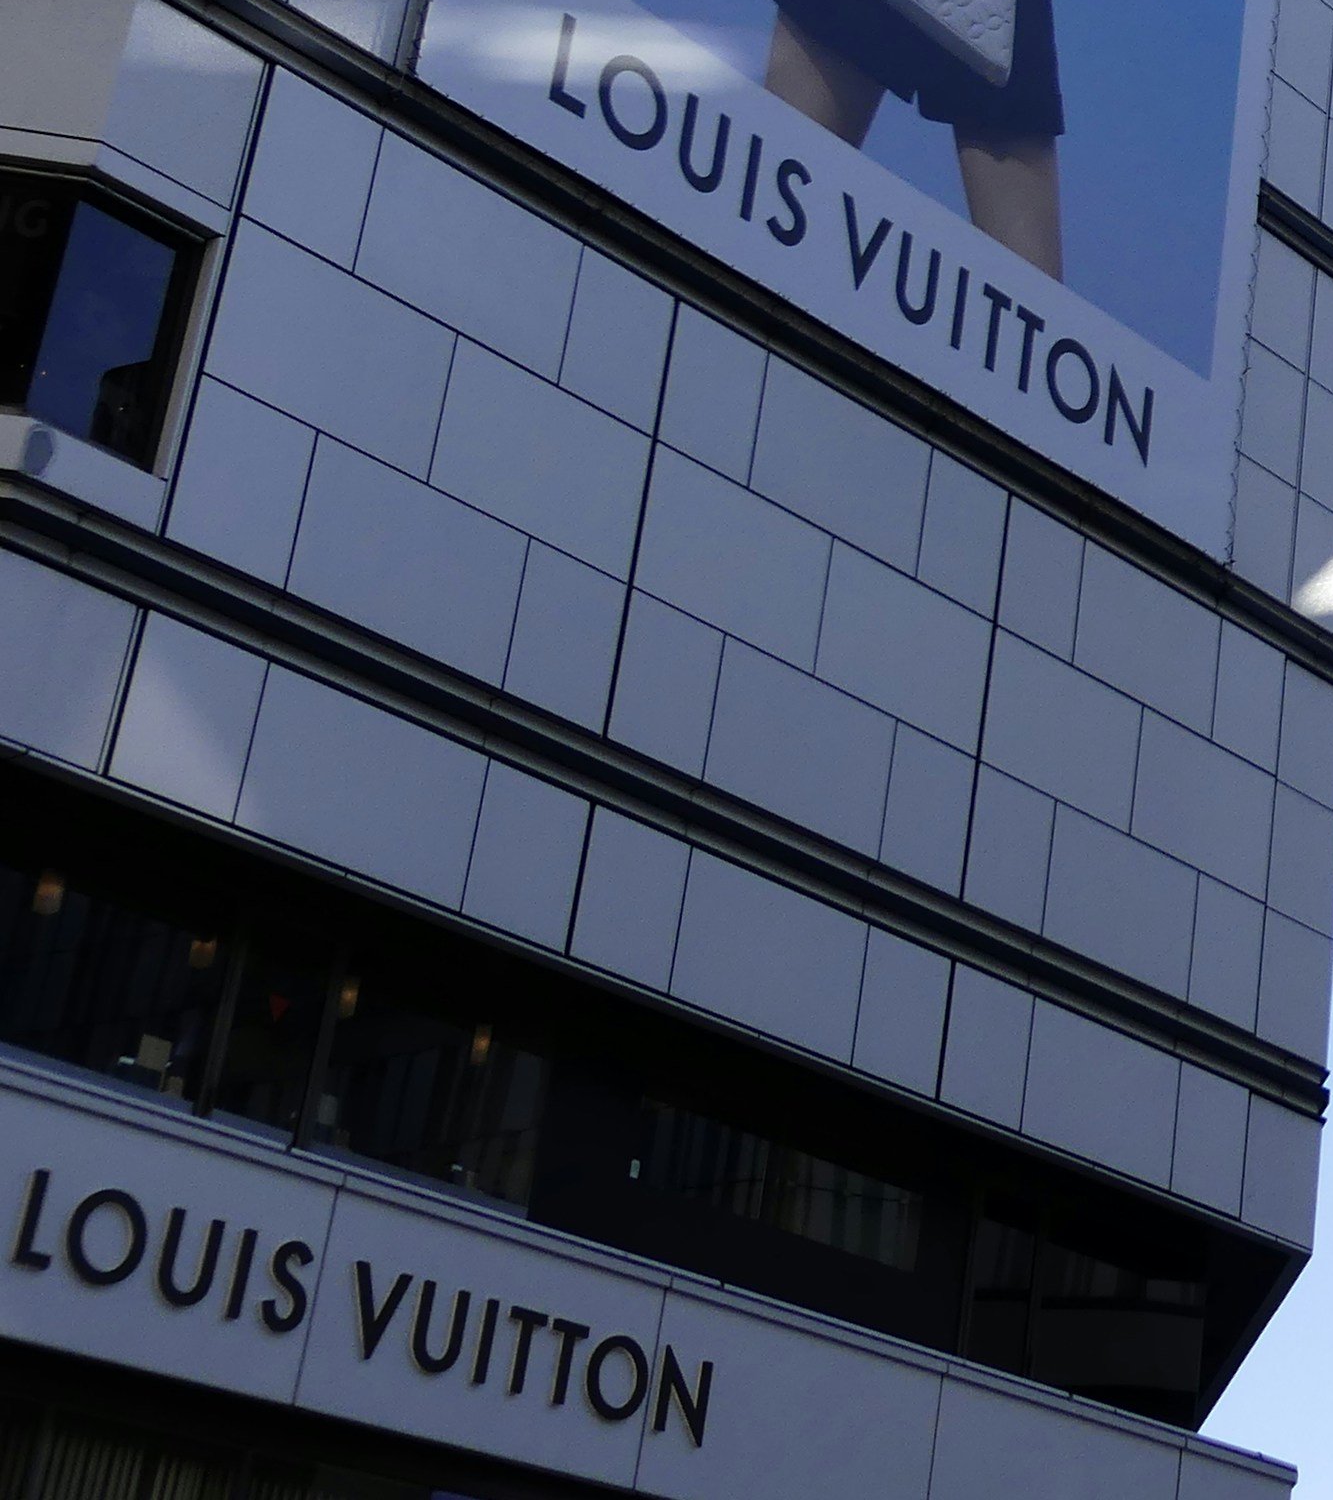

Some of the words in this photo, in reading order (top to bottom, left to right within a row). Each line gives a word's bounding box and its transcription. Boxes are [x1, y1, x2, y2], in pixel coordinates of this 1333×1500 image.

[548, 13, 813, 247] LOUIS
[843, 191, 1155, 468] VUITTON
[12, 1168, 315, 1333] LOUIS
[355, 1259, 714, 1448] VUITTON
